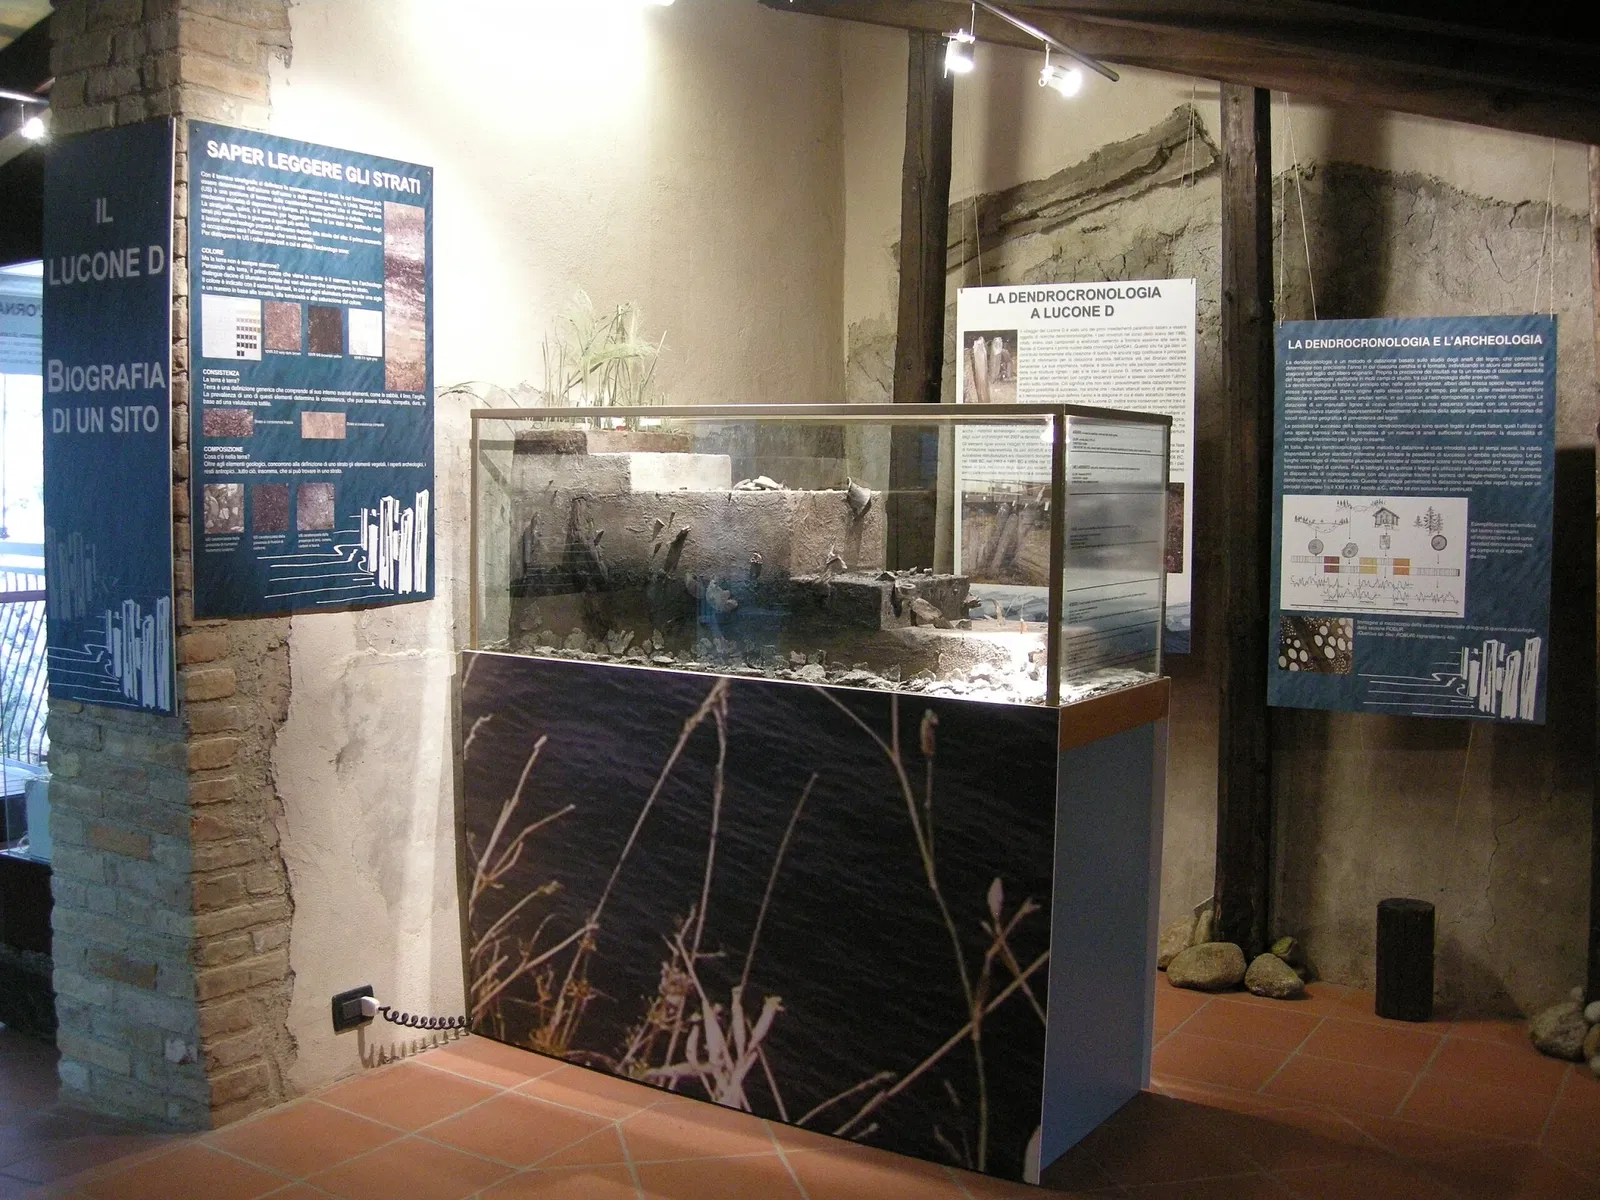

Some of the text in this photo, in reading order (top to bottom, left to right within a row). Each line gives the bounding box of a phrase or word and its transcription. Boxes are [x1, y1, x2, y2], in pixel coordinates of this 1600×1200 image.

[206, 140, 421, 194] SAPER LEGGERE GLI STRATI
[96, 198, 114, 223] IL
[50, 245, 165, 285] LUCONE D
[988, 287, 1162, 304] LA DENDROCRONOLOGIA
[1030, 305, 1115, 319] A LUCONE D
[1288, 334, 1543, 349] LA DENDROCRONOLOGIA E L'ARCHEOLOGIA
[48, 359, 166, 393] BIOGRAFIA
[53, 405, 159, 434] DI UN SITO
